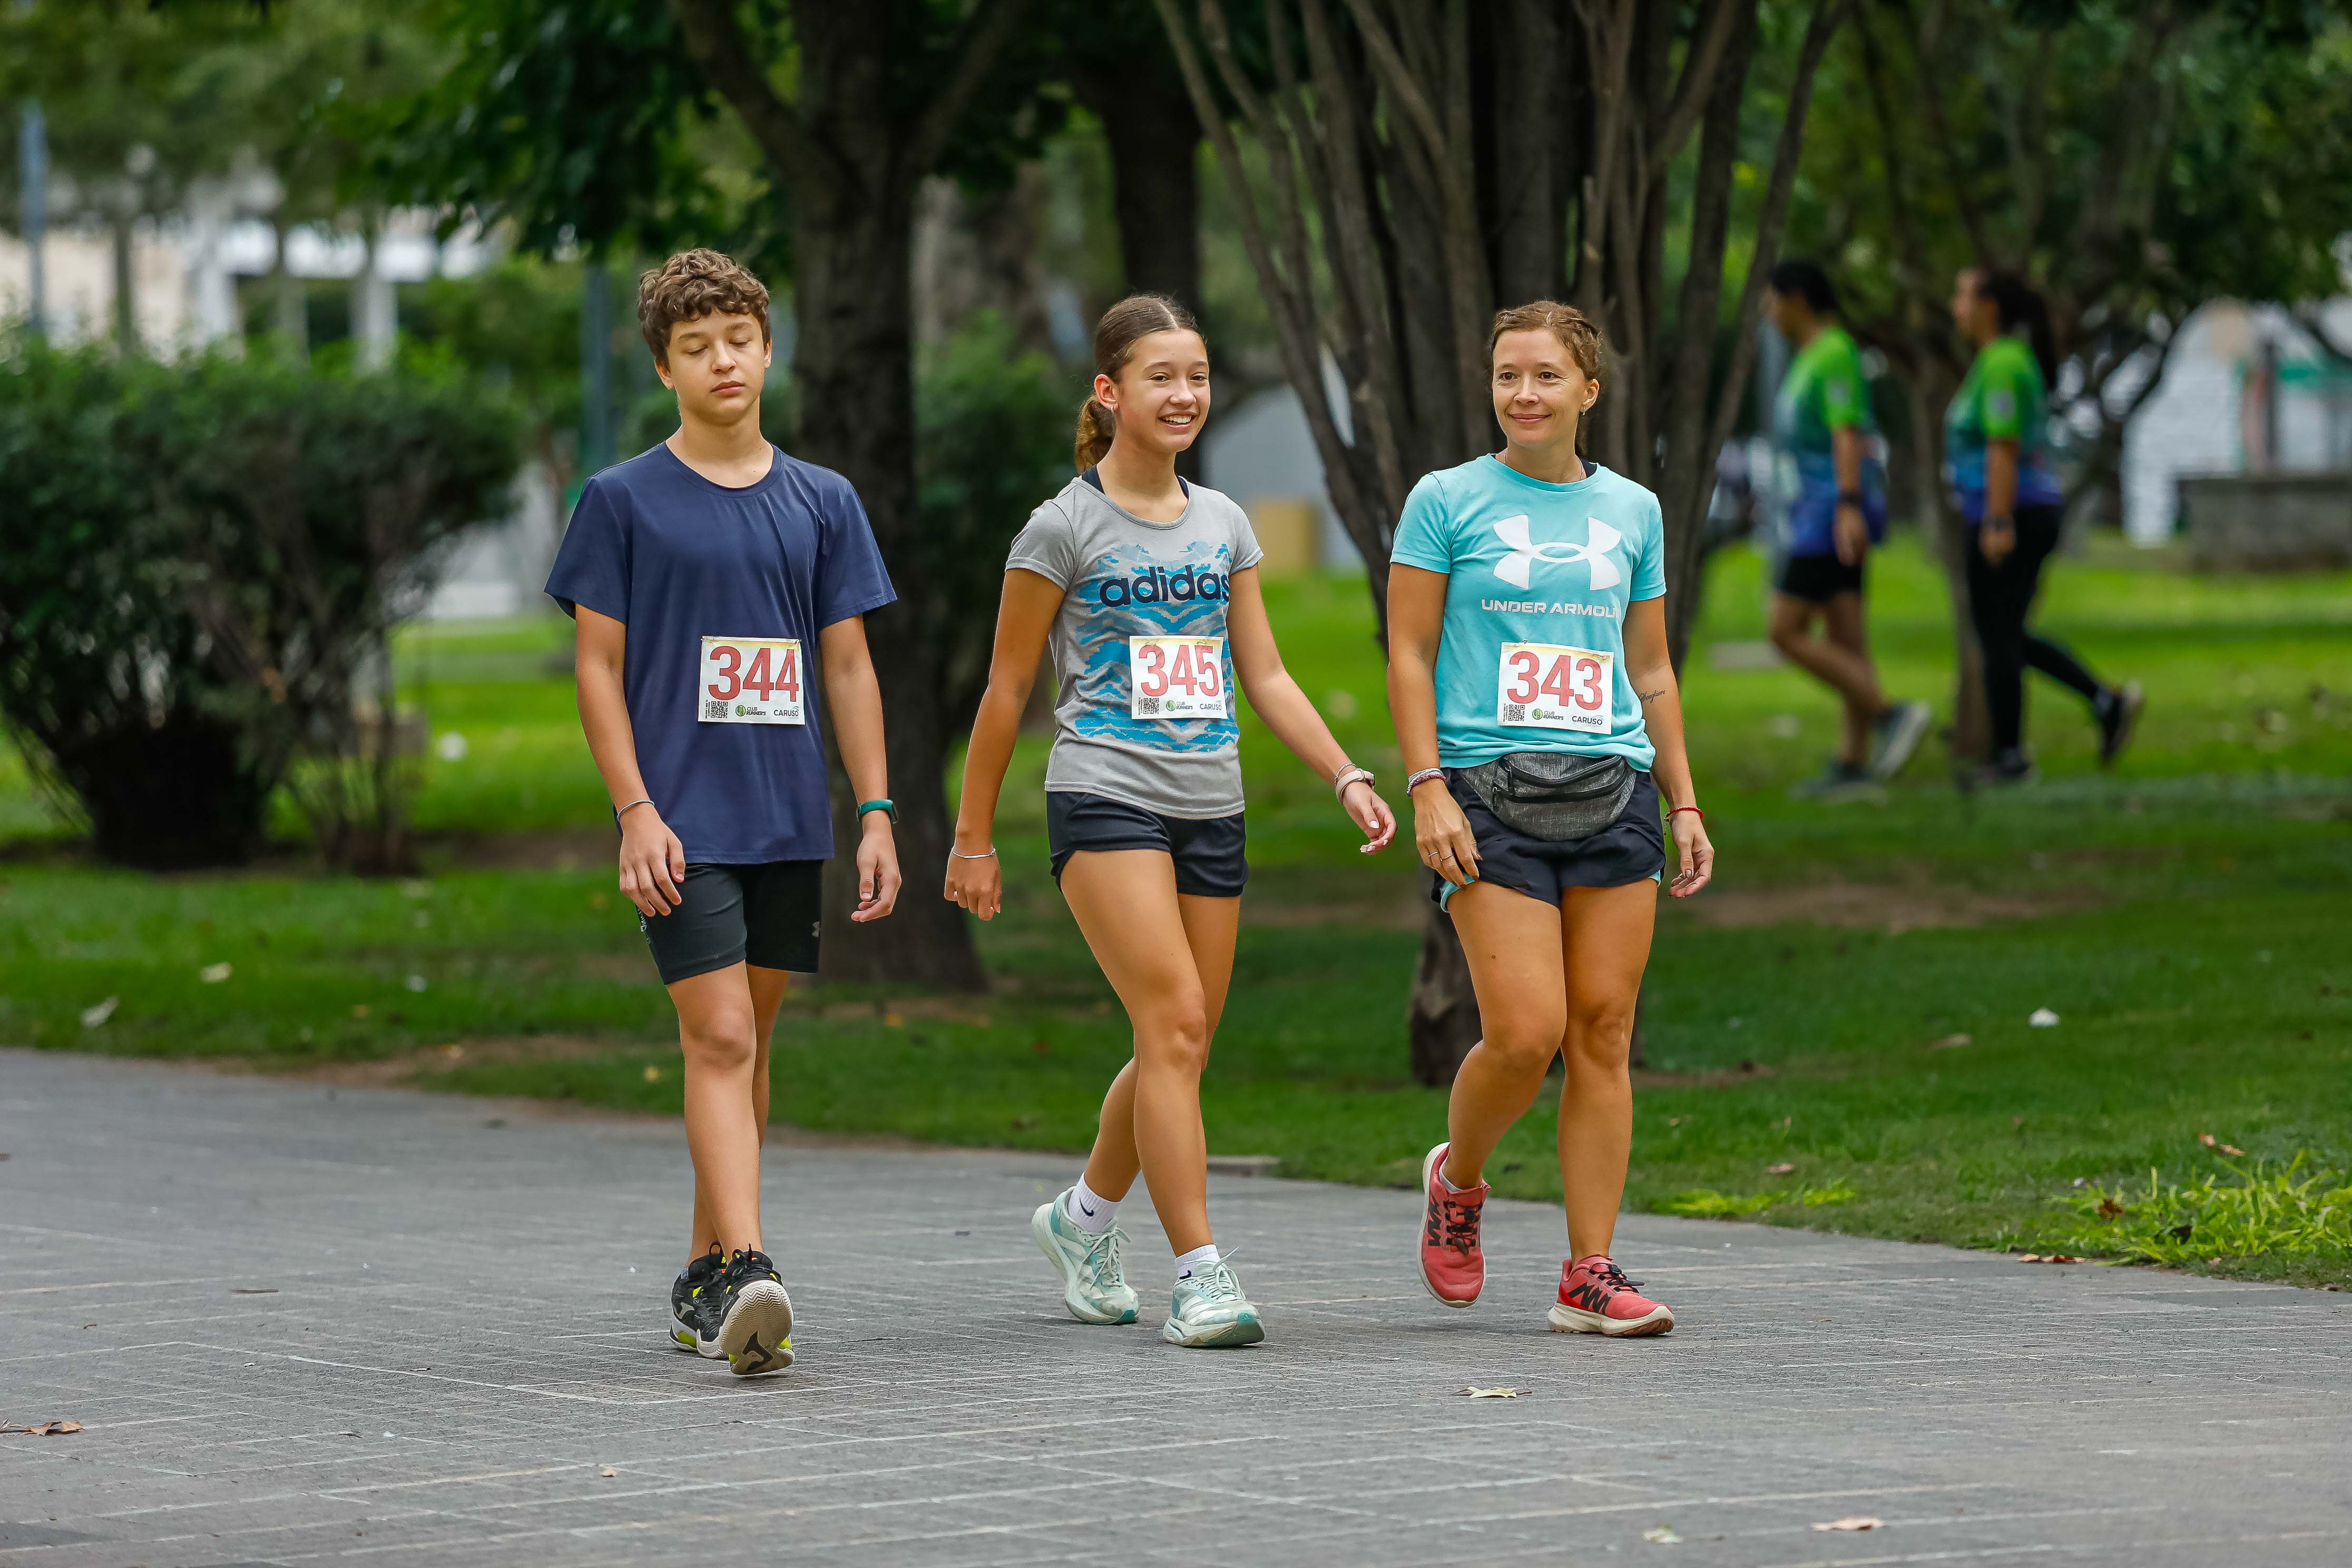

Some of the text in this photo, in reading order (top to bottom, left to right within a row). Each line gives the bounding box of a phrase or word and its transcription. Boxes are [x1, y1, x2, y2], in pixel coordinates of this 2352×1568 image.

[1099, 565, 1230, 607] adidas
[1481, 599, 1547, 613] UNDER
[708, 645, 799, 702] 344
[1139, 644, 1219, 697] 345
[1507, 651, 1603, 710] 343
[1572, 716, 1603, 726] CARUSO
